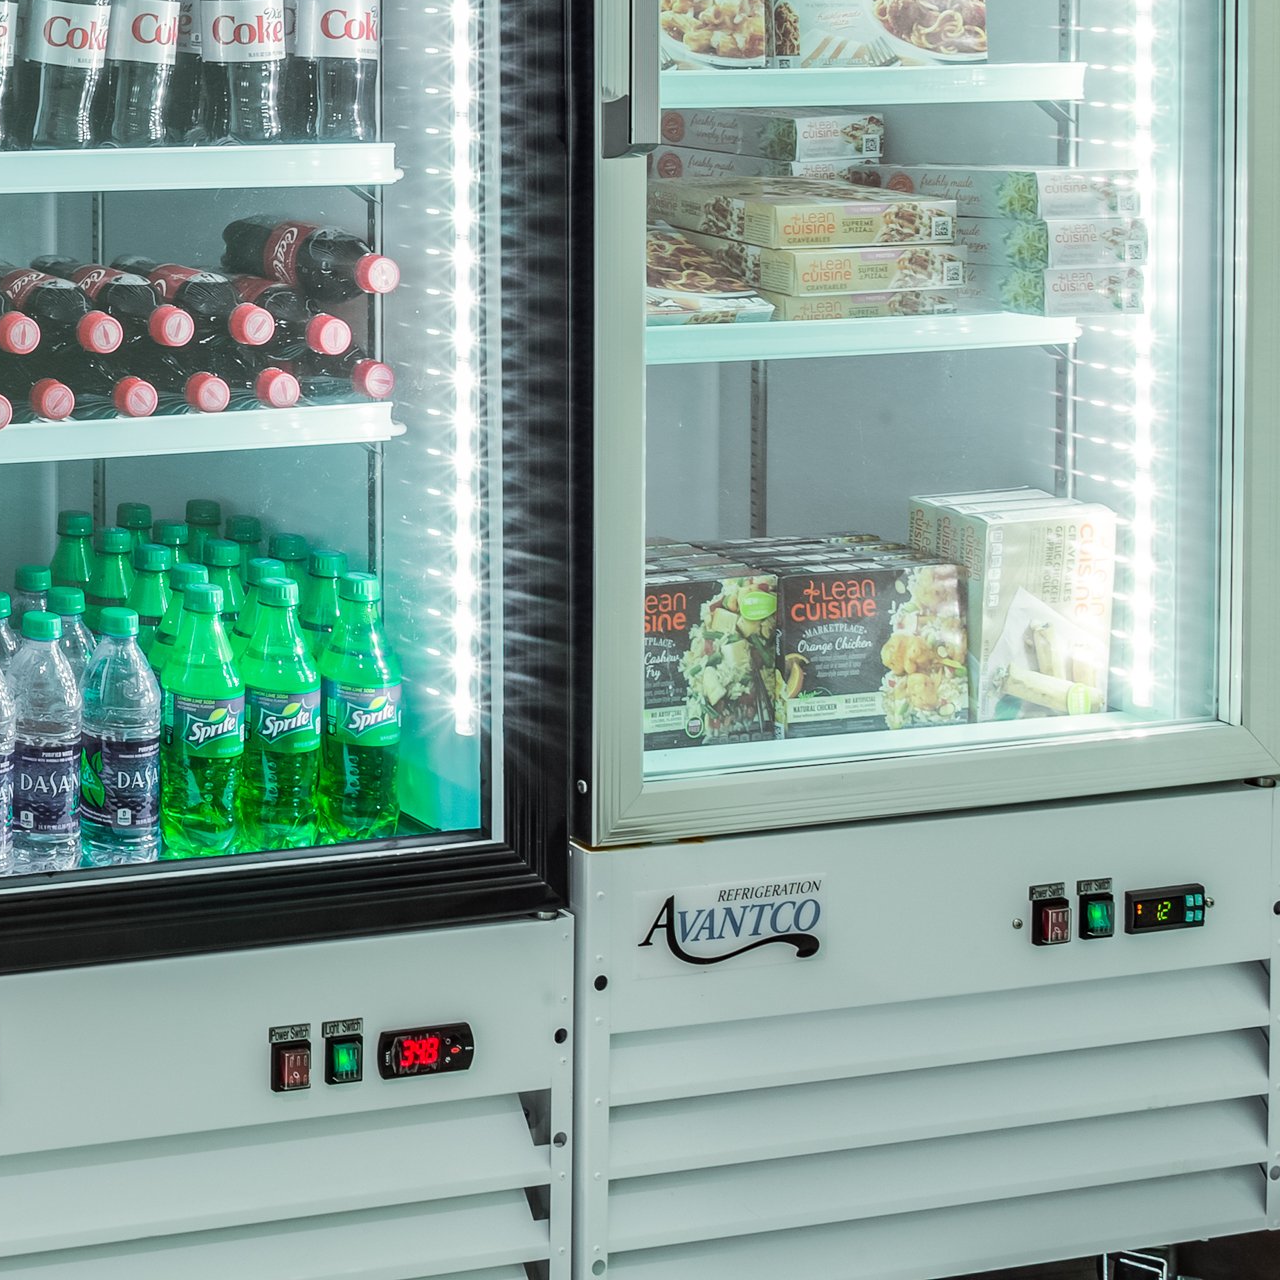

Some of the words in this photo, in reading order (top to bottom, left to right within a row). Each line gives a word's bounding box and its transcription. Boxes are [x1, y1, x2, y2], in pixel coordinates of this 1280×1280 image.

[802, 212, 835, 223] Lean
[822, 579, 875, 600] Lean
[791, 598, 876, 621] cuisine
[798, 640, 832, 656] Orange
[835, 636, 872, 651] Chicken
[645, 651, 680, 664] Cashew
[646, 667, 660, 680] Fry
[349, 703, 394, 729] Sprite
[793, 705, 815, 713] NATURAL
[817, 703, 837, 711] CHICKEN
[190, 715, 236, 743] Sprite
[263, 710, 310, 737] Sprite
[718, 880, 821, 902] REFRIGERATION
[1032, 888, 1047, 898] Power
[1048, 885, 1064, 897] Switch
[1080, 881, 1093, 893] Light
[1095, 878, 1111, 891] Switch
[638, 895, 820, 963] AVANTCO
[271, 1030, 289, 1040] Power
[291, 1027, 309, 1039] Switch
[325, 1022, 340, 1035] Light
[342, 1020, 361, 1033] Switch
